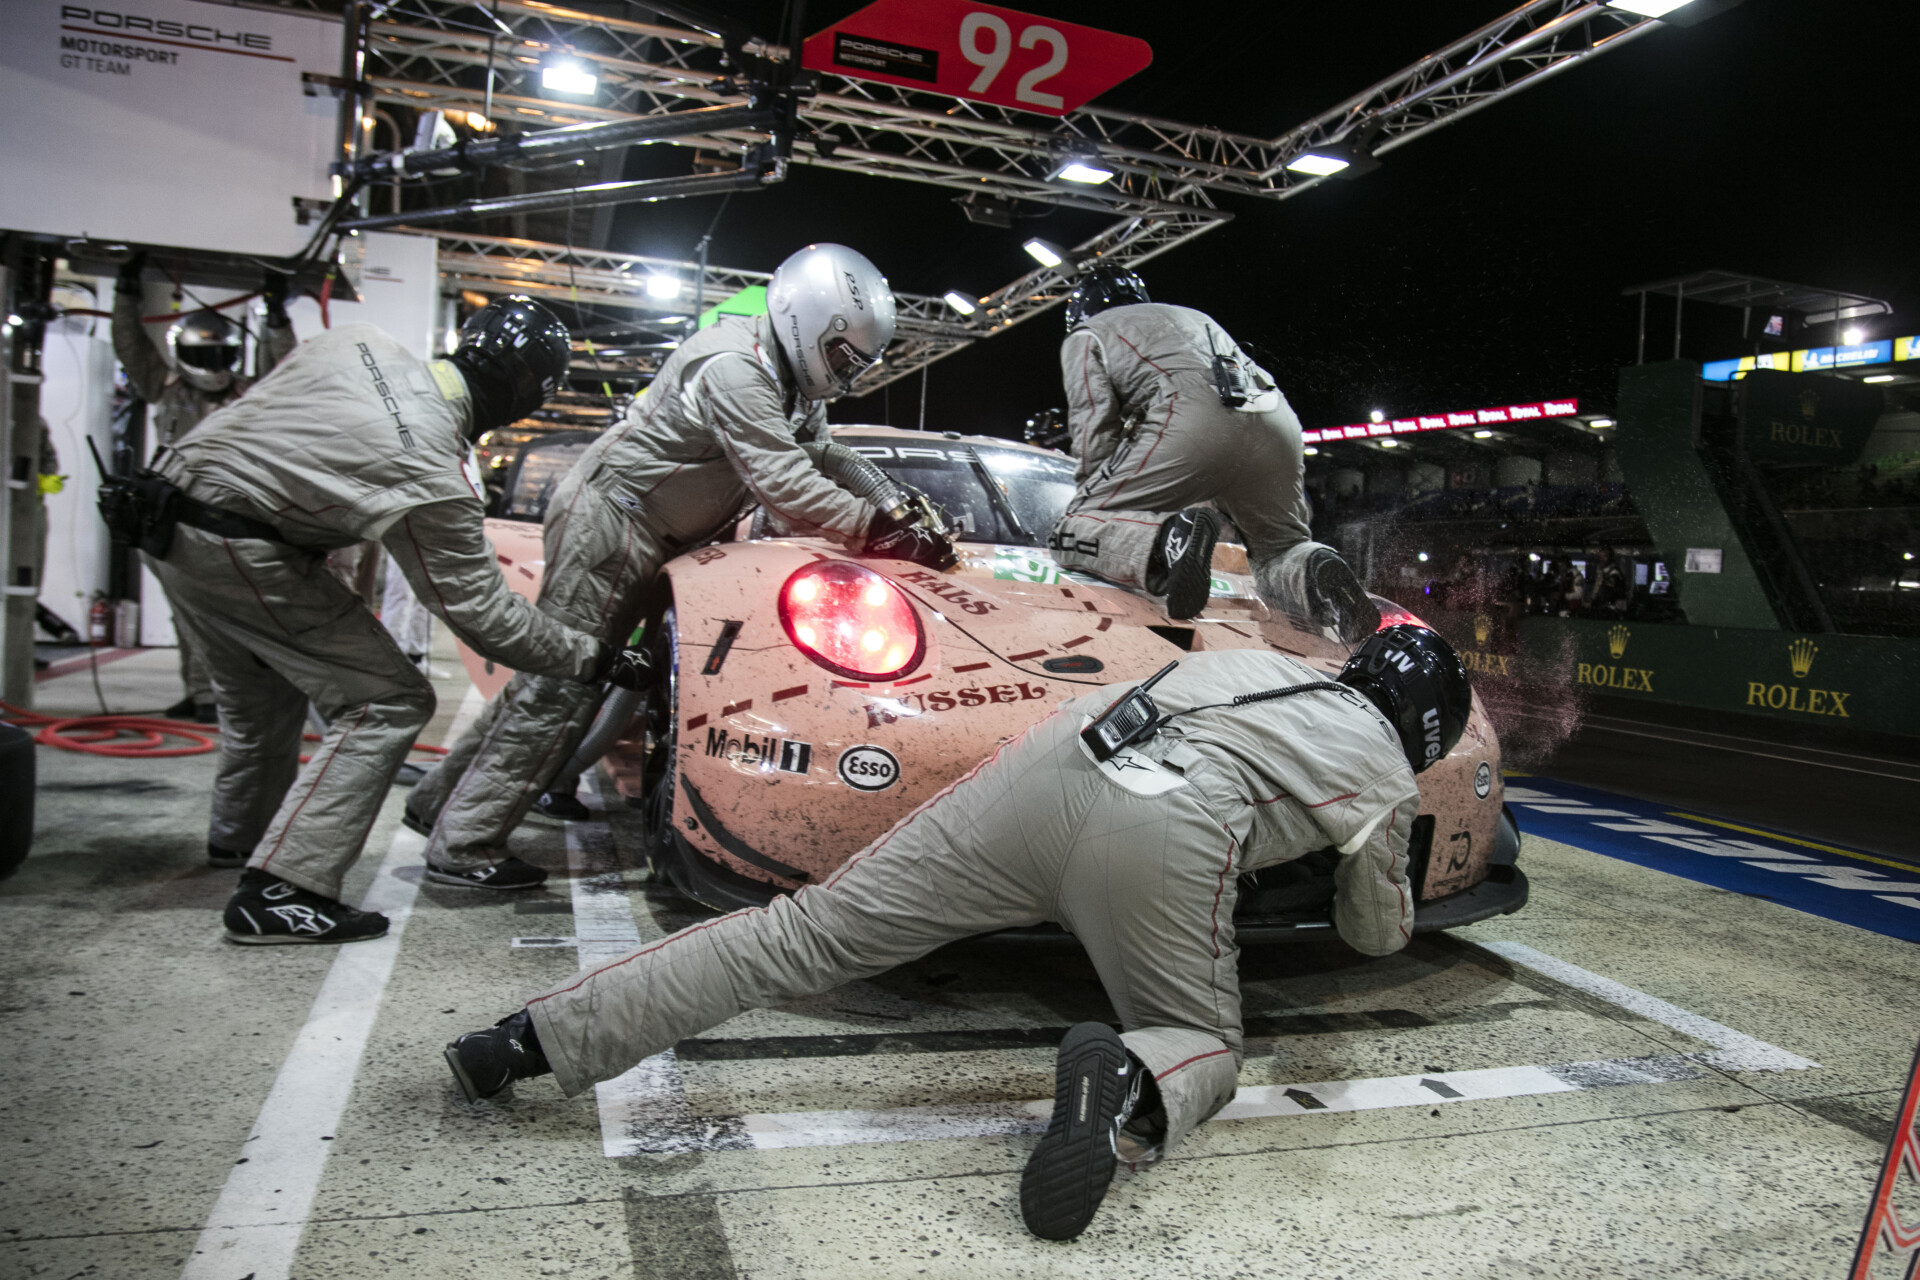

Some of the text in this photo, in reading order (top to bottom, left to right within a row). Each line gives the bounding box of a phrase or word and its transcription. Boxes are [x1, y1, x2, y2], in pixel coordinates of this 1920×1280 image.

[61, 5, 272, 50] PORSCHE
[60, 36, 180, 65] MOTORSPORT
[60, 54, 131, 76] GT TEAM
[839, 53, 887, 68] MOTORSPORT
[840, 39, 923, 63] PORSCHE
[959, 12, 1068, 110] 92
[790, 314, 815, 387] PORSCHE
[355, 342, 416, 449] PORSCHE
[1771, 421, 1843, 449] ROLEX
[898, 571, 1000, 616] HALS
[1577, 662, 1654, 692] ROLEX
[862, 682, 1046, 729] RÜSSEL
[1746, 681, 1851, 718] ROLEX
[705, 727, 777, 766] Mobil
[849, 756, 890, 778] Esso
